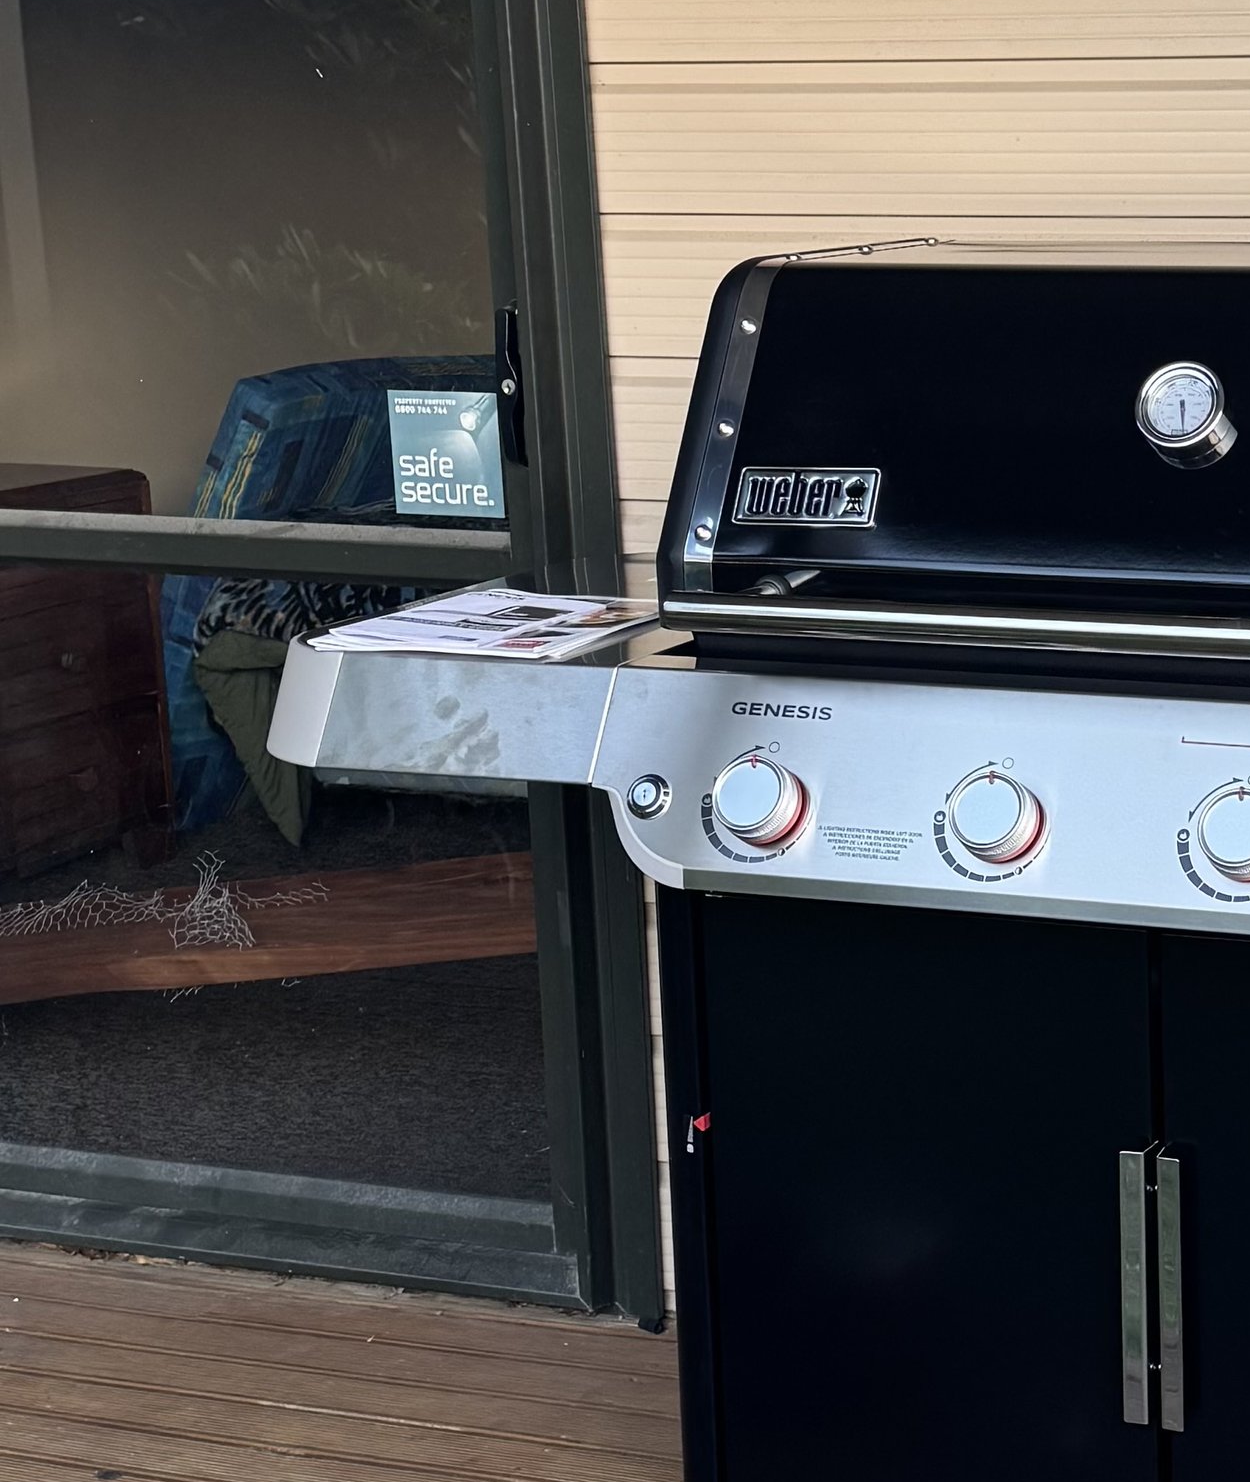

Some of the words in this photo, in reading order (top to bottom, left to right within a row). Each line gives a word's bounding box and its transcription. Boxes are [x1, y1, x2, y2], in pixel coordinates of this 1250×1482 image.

[395, 405, 416, 414] 0800
[399, 447, 454, 479] safe
[401, 481, 495, 507] secure.
[745, 470, 843, 517] weber
[731, 701, 833, 721] GENESIS
